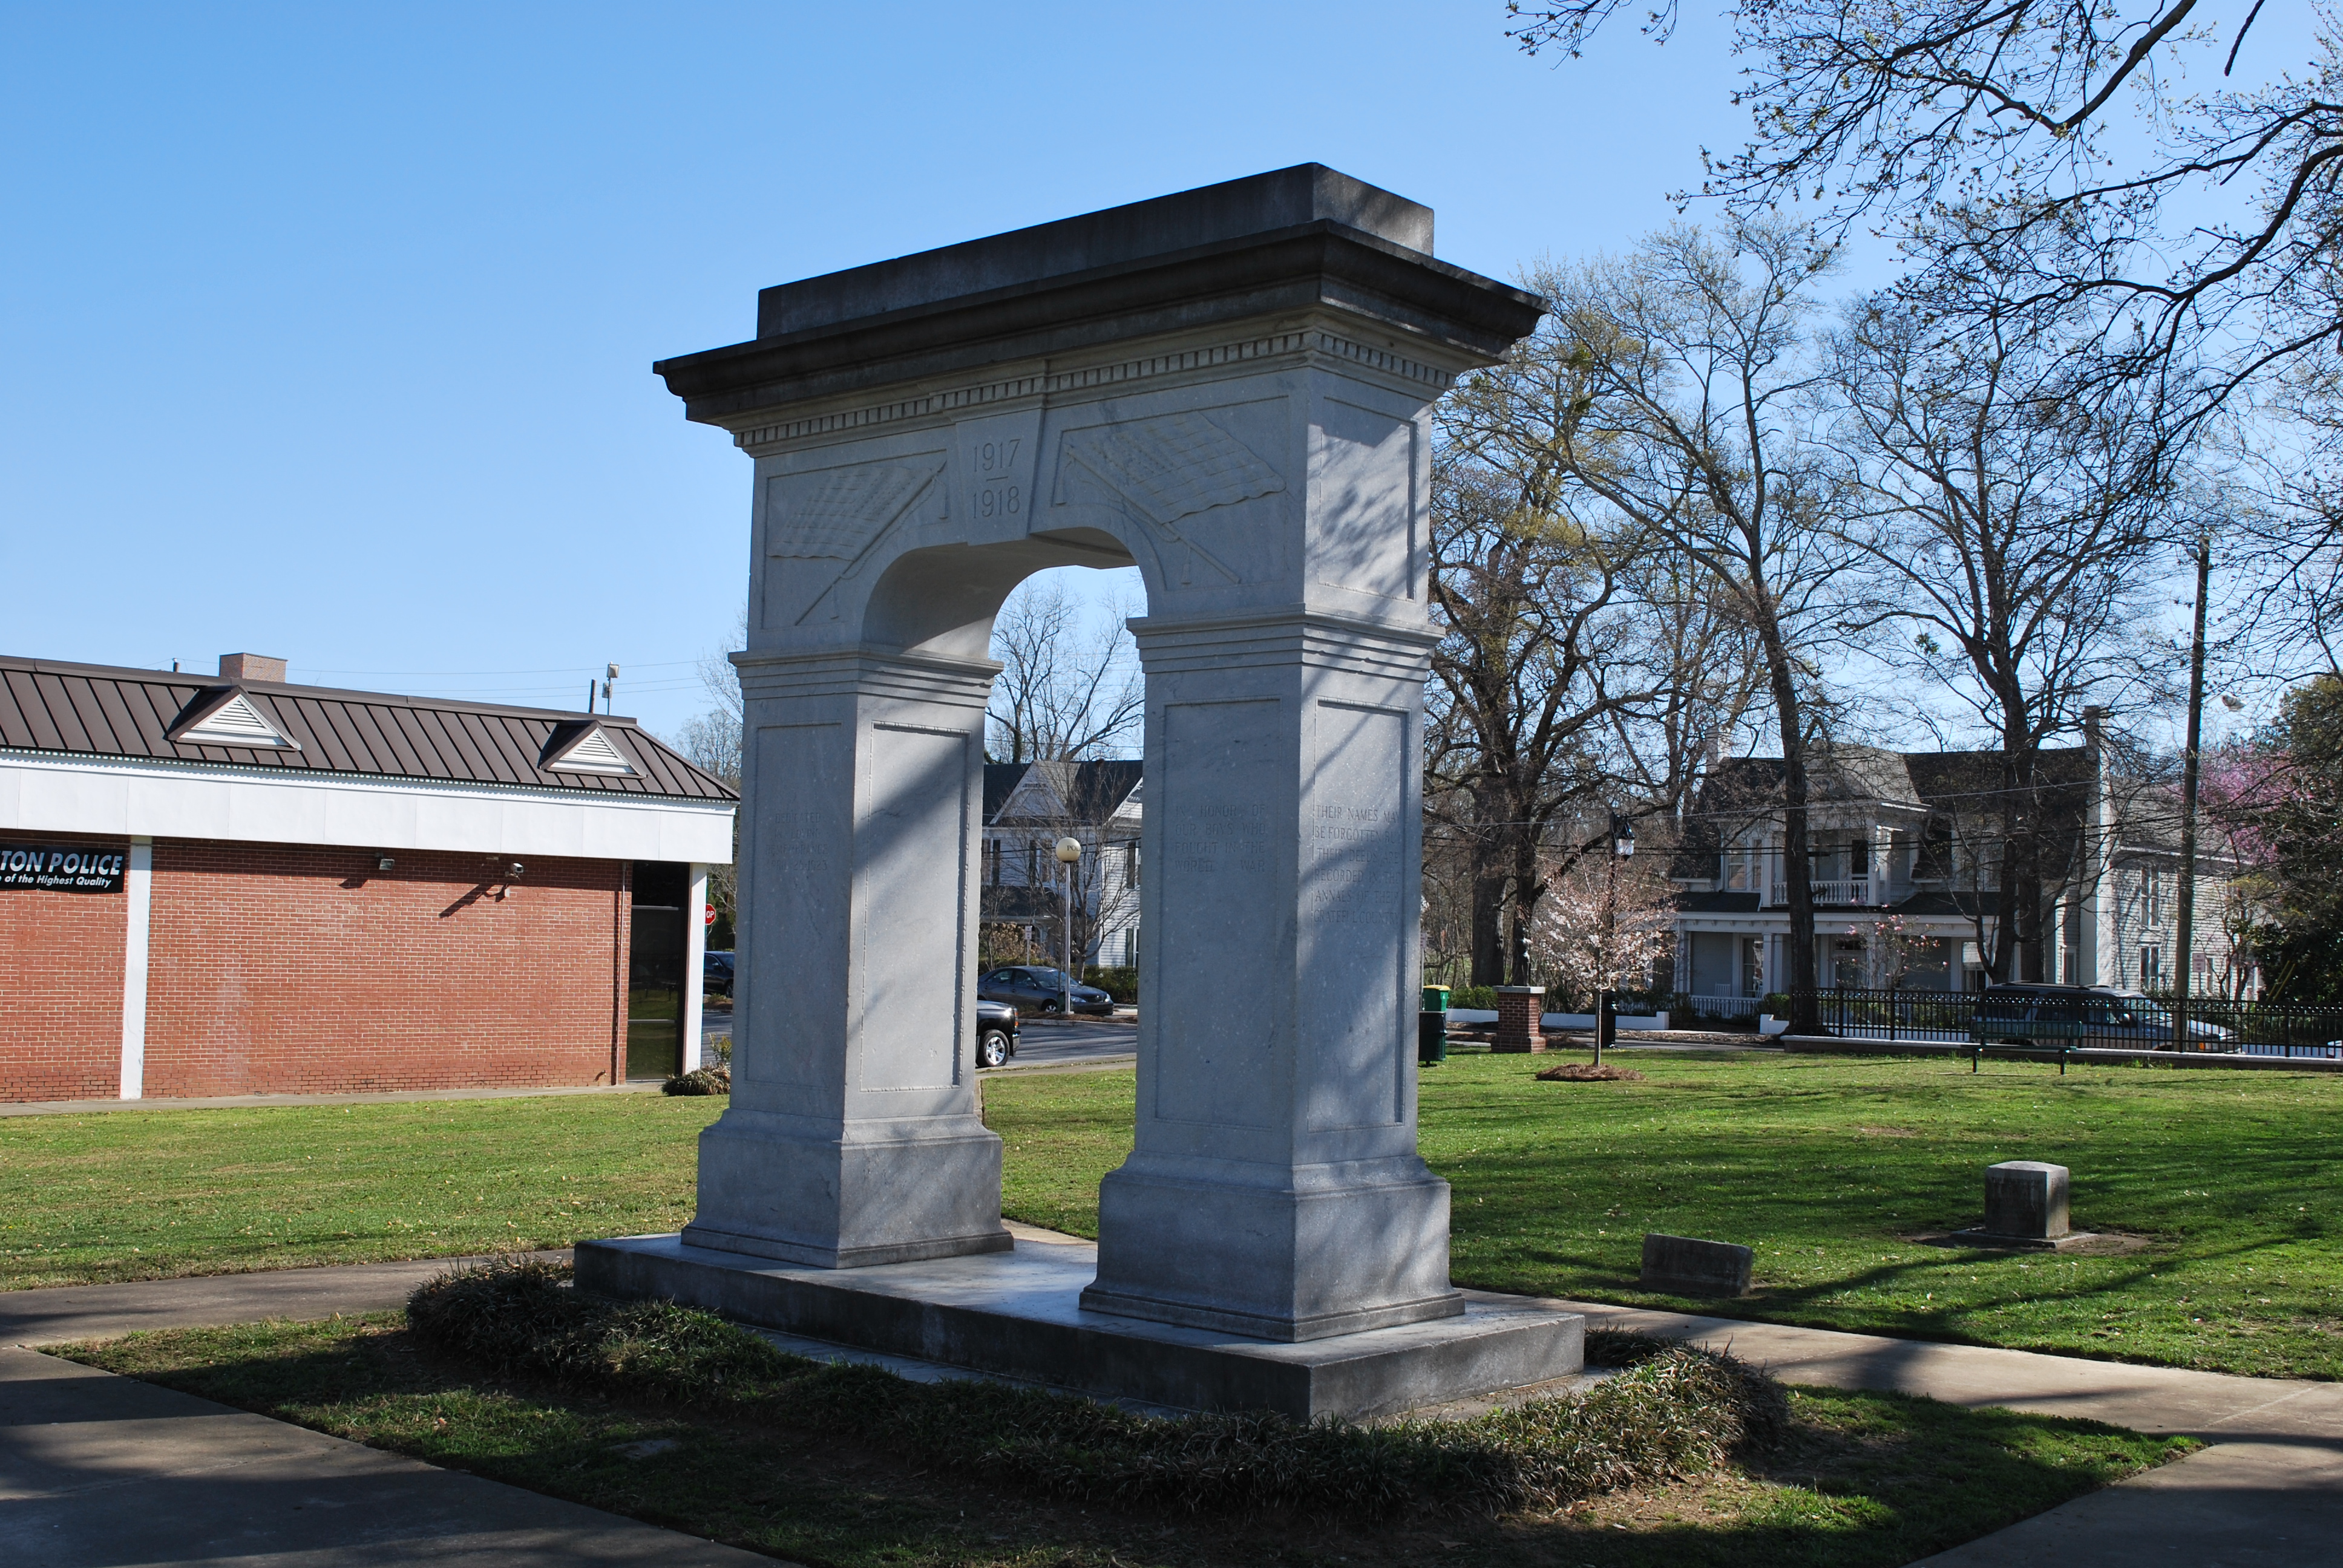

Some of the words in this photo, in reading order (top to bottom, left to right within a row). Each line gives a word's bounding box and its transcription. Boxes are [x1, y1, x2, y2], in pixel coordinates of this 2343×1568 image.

[974, 439, 1021, 472] 1917
[972, 486, 1020, 519] 1918
[775, 812, 821, 823] DEDICATED
[1175, 806, 1186, 817] IN
[1200, 805, 1237, 817] HONOR
[1252, 804, 1266, 817] OF
[1316, 805, 1342, 820] THEIR
[1348, 808, 1378, 822] NAMES
[1383, 811, 1400, 823] MAY
[1175, 823, 1196, 836] OUR
[1205, 822, 1233, 835] BOYS
[1242, 822, 1266, 835] WHO
[1315, 825, 1325, 839] BE
[1328, 826, 1381, 843] FORGOTTEN
[765, 844, 828, 855] REMEMBRANCE
[1175, 842, 1218, 854] FOUGHT
[1225, 841, 1236, 854] IN
[1244, 841, 1265, 854] THE
[0, 850, 45, 872] TON
[48, 852, 123, 875] POLICE
[1317, 848, 1343, 861] THEIR
[1349, 849, 1378, 863] DEEDS
[1381, 852, 1400, 864] ARE
[1175, 859, 1214, 872] WORLD
[1240, 859, 1265, 872] WAR
[4, 873, 17, 883] of
[18, 874, 34, 884] the
[36, 874, 74, 886] Highest
[76, 876, 112, 888] Quality
[1314, 868, 1364, 883] RECORDED
[1369, 871, 1378, 883] IN
[1315, 889, 1352, 903] ANNALS
[1357, 890, 1369, 903] OF
[1374, 891, 1399, 904] THEIR
[1314, 909, 1357, 923] GRATEFUL
[1360, 911, 1400, 925] COUNTRY
